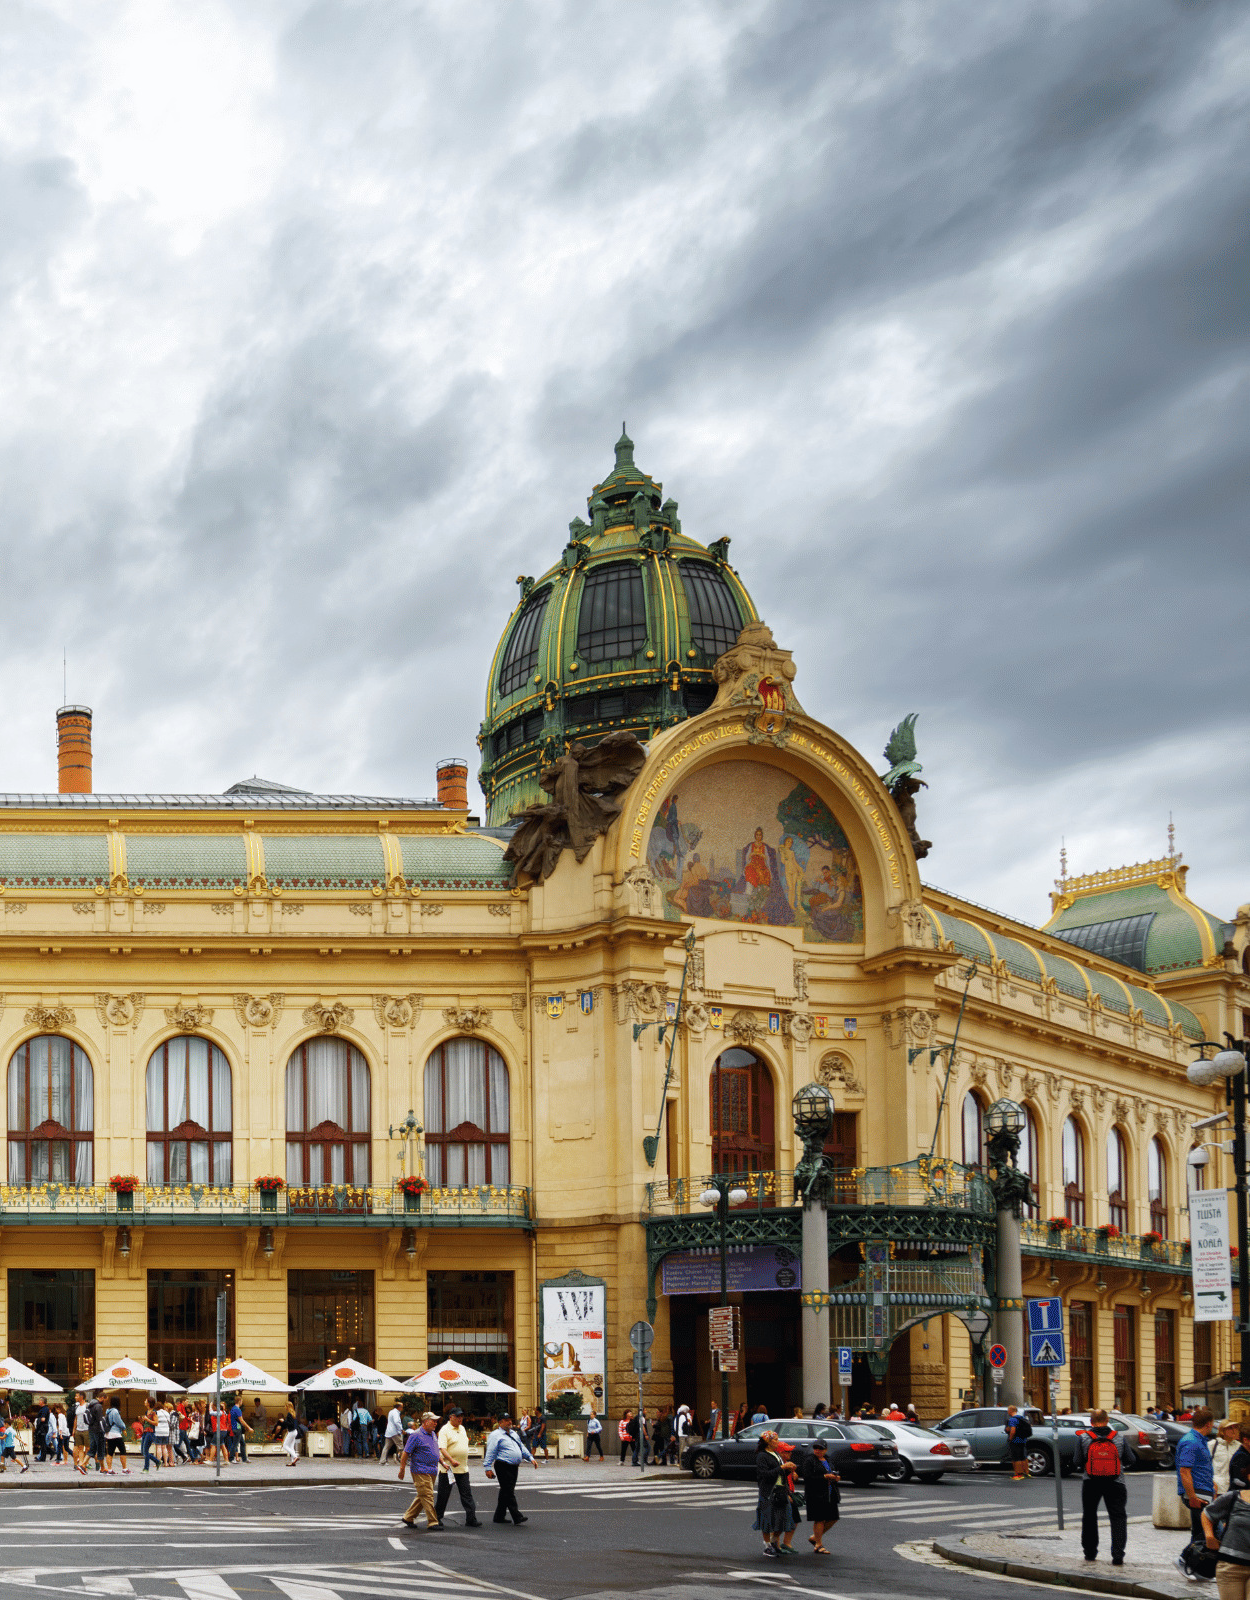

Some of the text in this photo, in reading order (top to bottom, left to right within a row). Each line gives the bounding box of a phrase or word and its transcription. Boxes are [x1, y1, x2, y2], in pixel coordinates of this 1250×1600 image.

[1198, 1238, 1223, 1249] KOALA
[842, 1351, 849, 1365] P
[10, 1376, 35, 1385] Urquell
[109, 1376, 157, 1387] Pilsner Urquell
[220, 1377, 266, 1389] Pilsner Urquell
[332, 1376, 383, 1388] Pilsner Urquell
[439, 1379, 488, 1390] Pilsner Urquell
